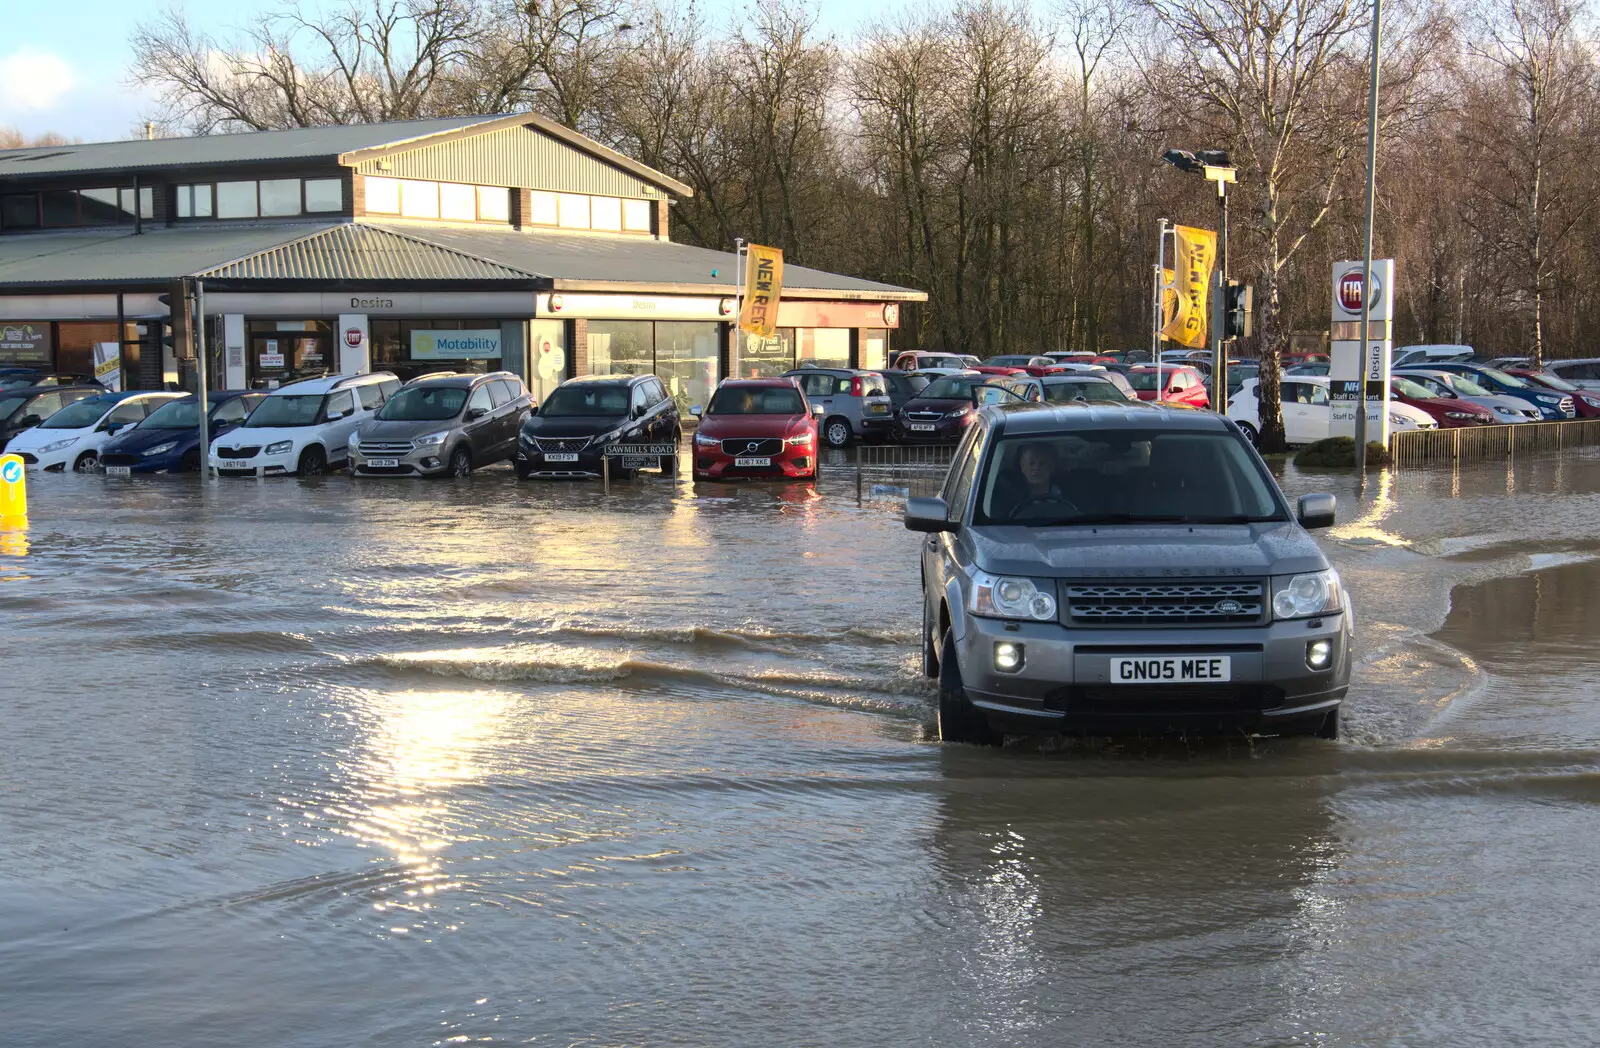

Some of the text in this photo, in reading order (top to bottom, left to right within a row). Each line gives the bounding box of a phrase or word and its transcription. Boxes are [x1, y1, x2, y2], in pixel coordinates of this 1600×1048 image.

[751, 258, 774, 327] NEW REG
[1343, 281, 1364, 302] FIA
[350, 296, 393, 308] Desira
[437, 337, 497, 352] Motability
[1371, 346, 1380, 380] Desira
[607, 445, 673, 454] SAWMILLS ROAD
[1120, 659, 1222, 679] GN05 MEE
